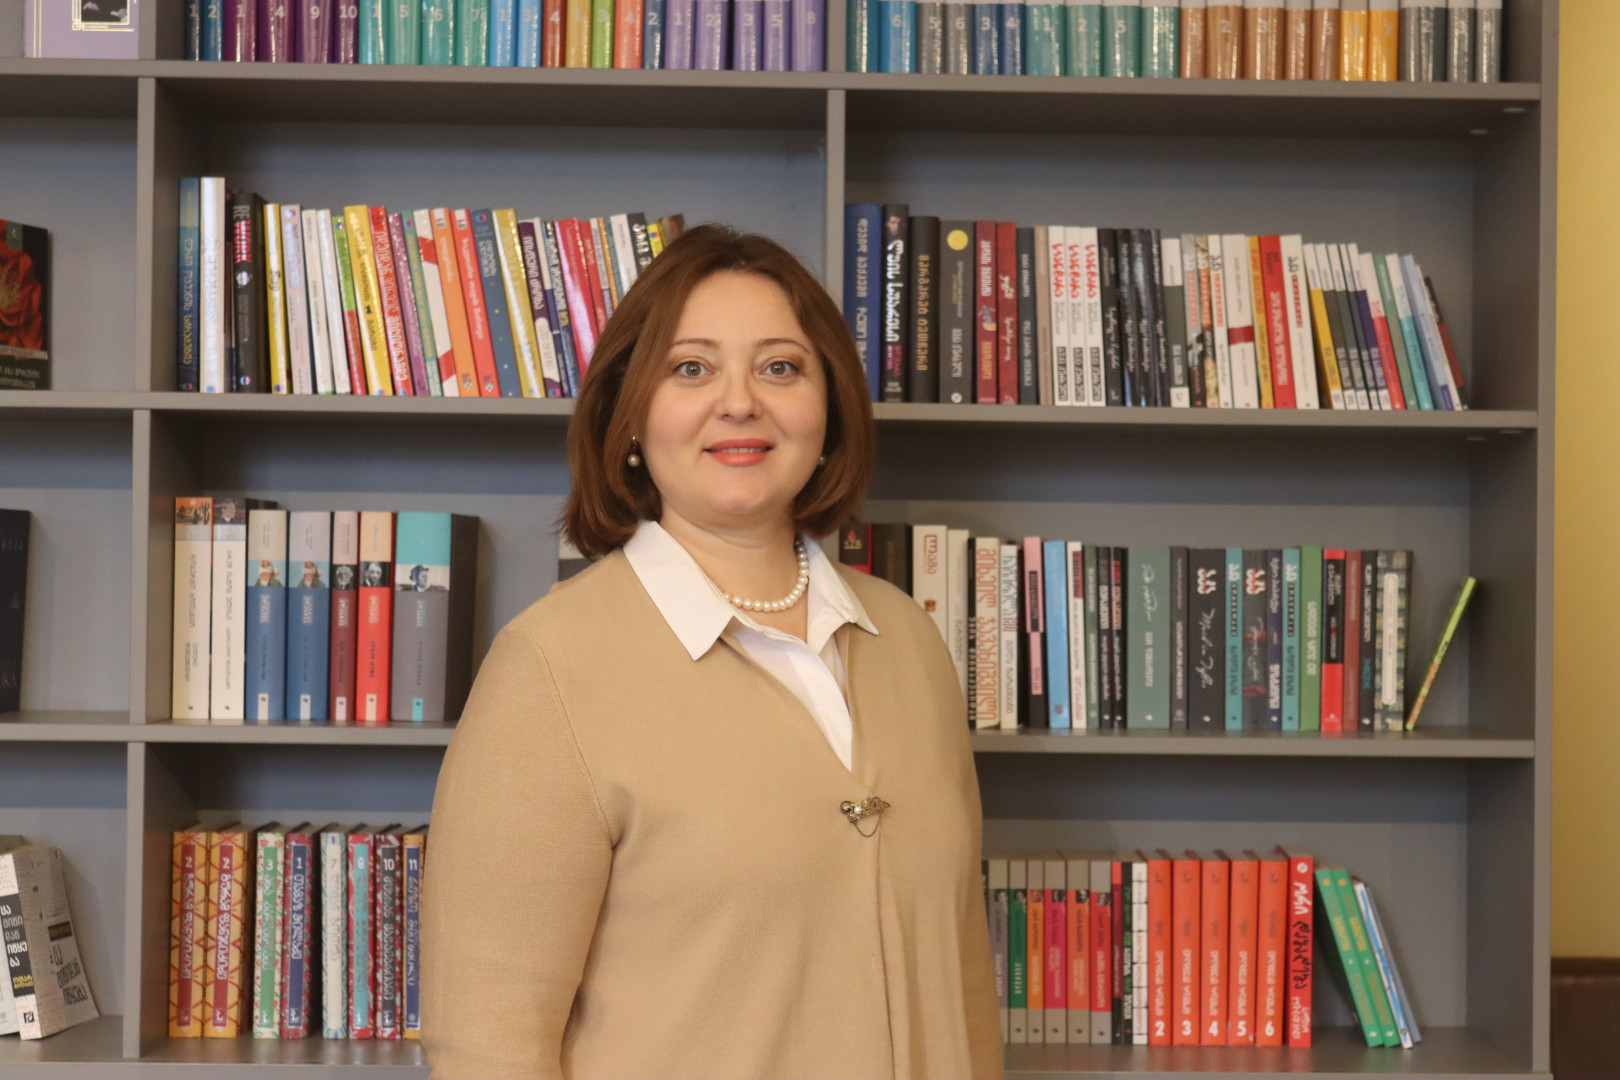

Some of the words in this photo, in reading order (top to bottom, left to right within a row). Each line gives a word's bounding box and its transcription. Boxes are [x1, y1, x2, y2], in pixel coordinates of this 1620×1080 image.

[190, 5, 198, 17] 1
[208, 6, 217, 18] 2
[237, 5, 245, 17] 1
[275, 6, 284, 18] 4
[310, 6, 320, 19] 9
[340, 6, 357, 18] 10
[400, 5, 409, 17] 5
[434, 9, 443, 21] 6
[471, 9, 480, 21] 7
[499, 9, 507, 21] 1
[522, 10, 532, 22] 3
[550, 10, 560, 23] 4
[626, 12, 634, 24] 4
[648, 13, 658, 25] 2
[674, 13, 683, 25] 1
[744, 13, 754, 26] 3
[892, 15, 901, 27] 6
[955, 18, 964, 29] 6
[981, 17, 990, 30] 3
[1077, 19, 1086, 32] 2
[232, 205, 252, 264] REWORK
[857, 218, 868, 252] დევიდ
[523, 236, 538, 278] იისფერი
[887, 239, 905, 279] ლუის
[980, 240, 992, 264] ანდრეს
[1288, 256, 1299, 273] აკა
[857, 256, 868, 298] ბექჰემი
[918, 255, 930, 314] მარგარეტ
[980, 267, 992, 296] ინიესტა
[528, 279, 544, 309] ძროხა
[374, 231, 389, 275] იდეიდან
[387, 315, 408, 381] მილიონამდე
[886, 282, 904, 342] სუარესი
[184, 315, 194, 365] სტრატეგია
[189, 554, 197, 590] რობერტო
[977, 549, 997, 608] მიხეილ
[189, 592, 197, 628] ბოლანიო
[1005, 640, 1014, 664] გელა
[977, 617, 997, 720] ჯავახიშვილი
[1005, 667, 1015, 714] ჩარკვიანი
[186, 857, 193, 868] 2
[223, 857, 230, 869] 2
[265, 859, 274, 871] 3
[296, 857, 303, 869] 1
[358, 857, 365, 868] 8
[384, 859, 394, 870] 10
[409, 860, 417, 870] 11
[183, 873, 194, 910] გურამ
[220, 873, 232, 910] გურამ
[293, 873, 304, 911] თამაზ
[1293, 882, 1312, 915] ორი
[181, 912, 193, 979] ფანჯიკიძე
[217, 912, 230, 980] ფანჯიკიძე
[1155, 1020, 1165, 1037] 2
[1181, 1020, 1192, 1036] 3
[1208, 1020, 1219, 1037] 4
[1237, 1020, 1247, 1037] 5
[1265, 1020, 1275, 1037] 6
